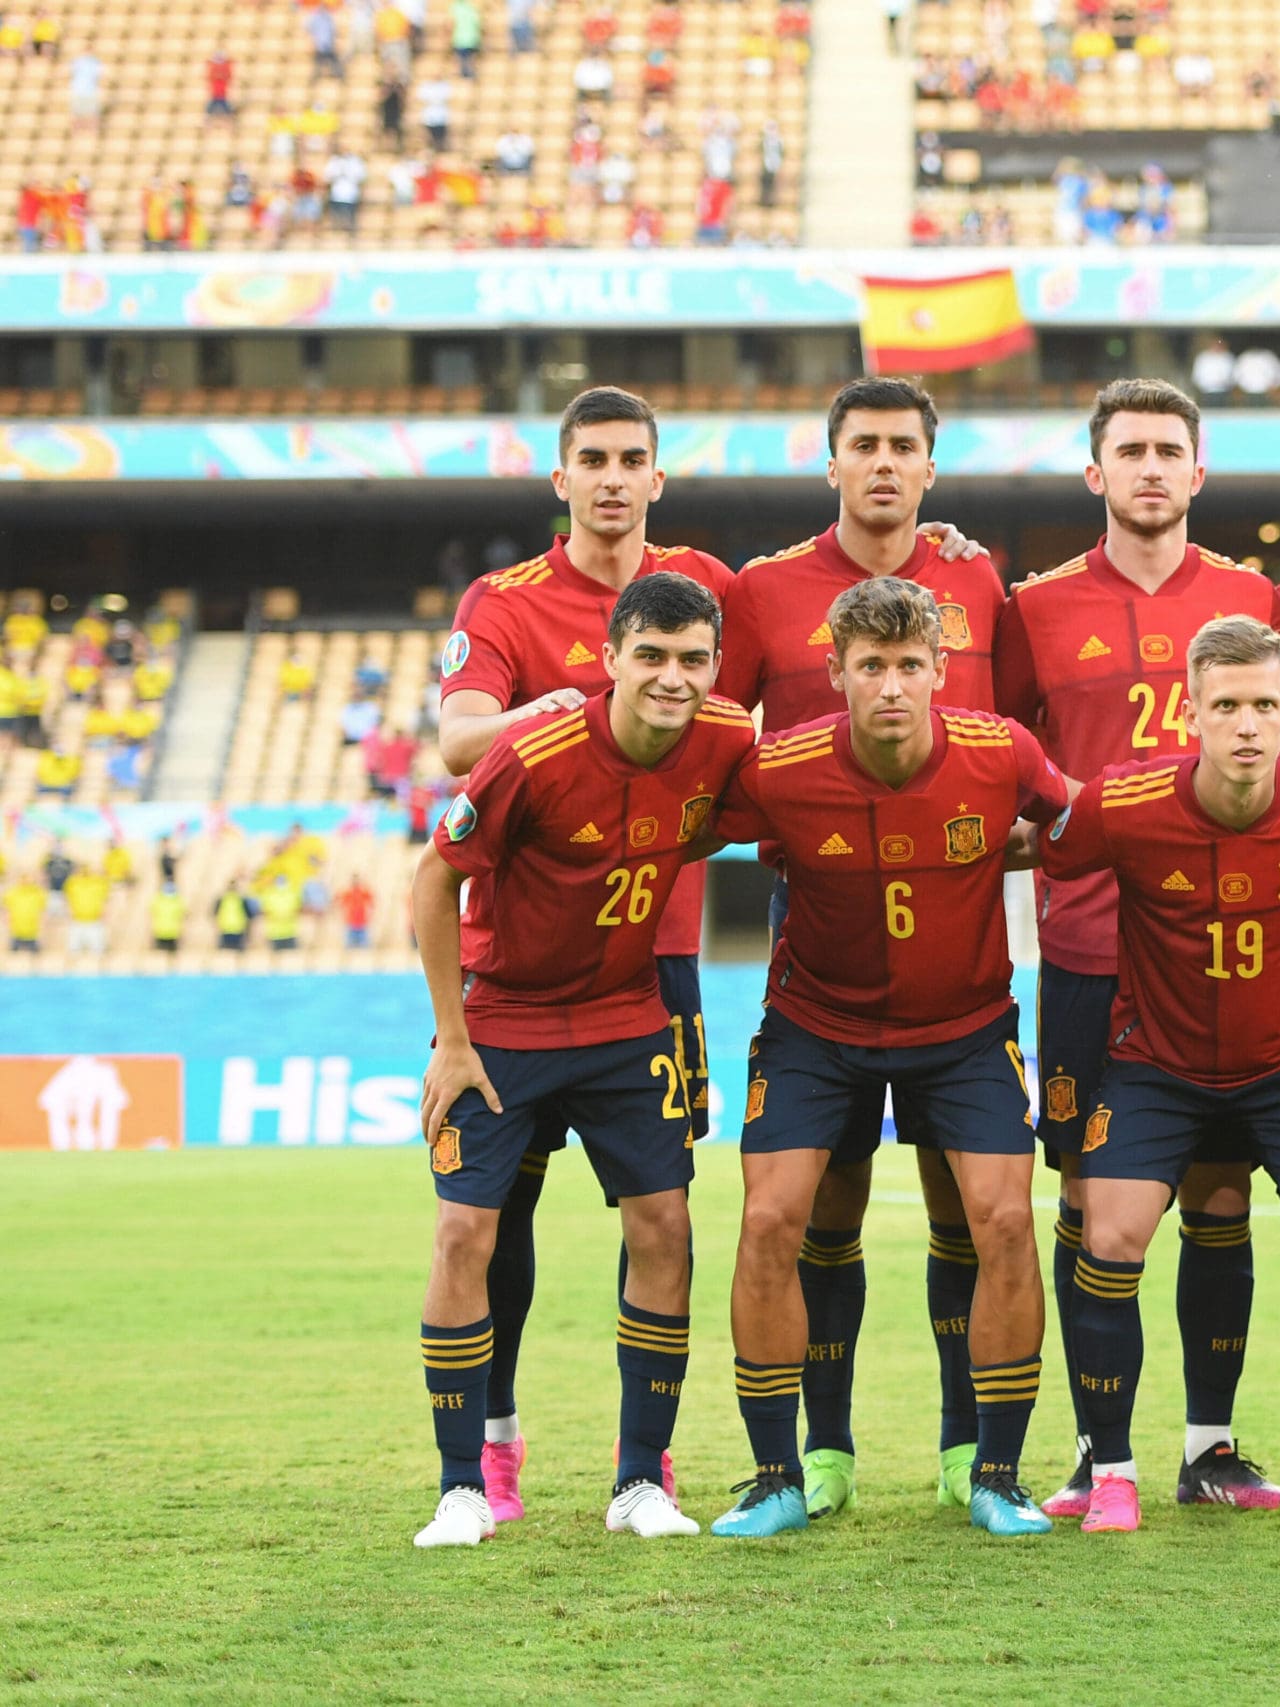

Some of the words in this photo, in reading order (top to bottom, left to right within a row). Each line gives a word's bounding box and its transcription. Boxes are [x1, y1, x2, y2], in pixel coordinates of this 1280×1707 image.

[1128, 682, 1188, 748] 24
[569, 833, 604, 843] adidas
[818, 846, 854, 856] adidas
[596, 863, 658, 926] 26
[1162, 882, 1195, 891] adidas
[886, 881, 914, 939] 6
[1205, 920, 1263, 979] 19
[217, 1056, 422, 1144] His
[934, 1316, 967, 1335] RFEF
[808, 1342, 845, 1361] RFEF
[1080, 1372, 1122, 1393] RFEF
[430, 1393, 465, 1409] RFEF
